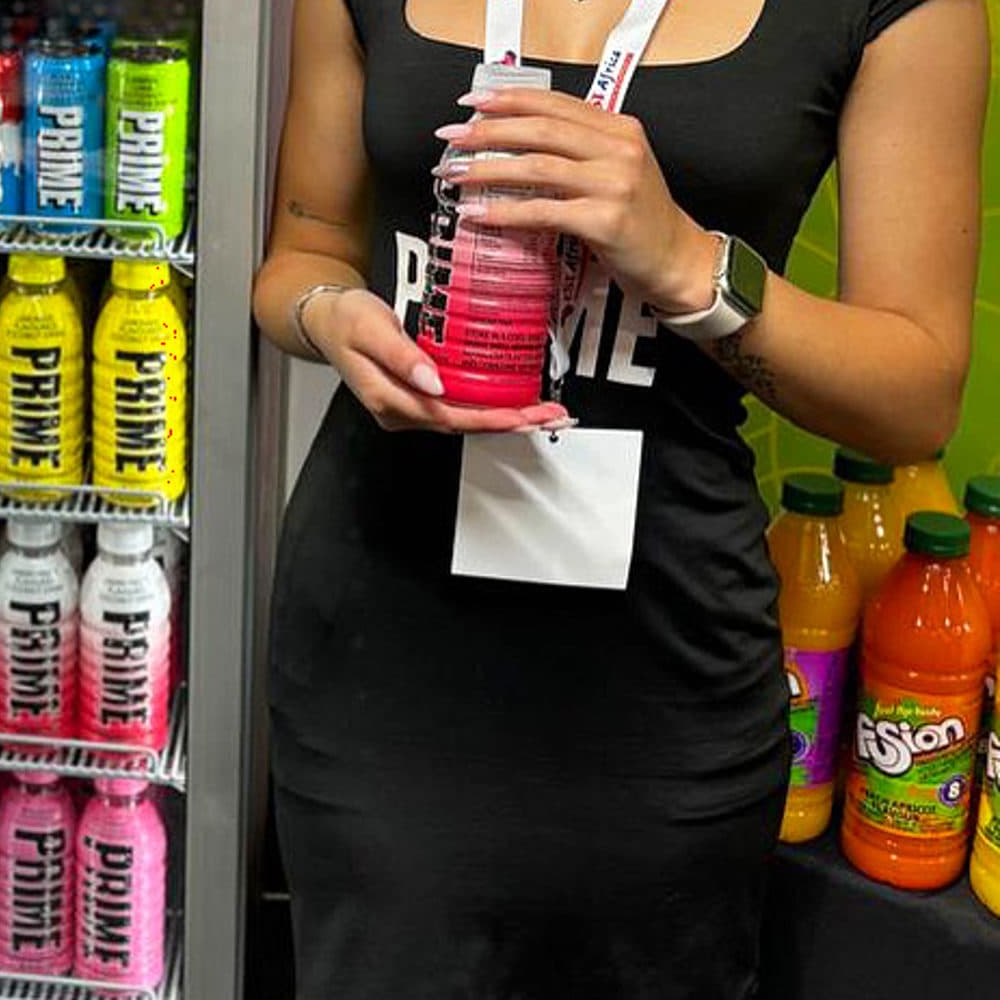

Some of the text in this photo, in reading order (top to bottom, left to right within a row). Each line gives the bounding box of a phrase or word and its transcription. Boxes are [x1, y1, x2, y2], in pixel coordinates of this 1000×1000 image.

[597, 50, 622, 92] Africa
[37, 105, 84, 211] PRIME
[117, 110, 168, 217] PRIME
[10, 346, 62, 470] PRIME
[115, 350, 168, 474] PRIME
[8, 599, 61, 718] PRIME
[101, 610, 151, 726] PRIME
[13, 828, 65, 951] PRIME
[84, 836, 134, 967] PRIME
